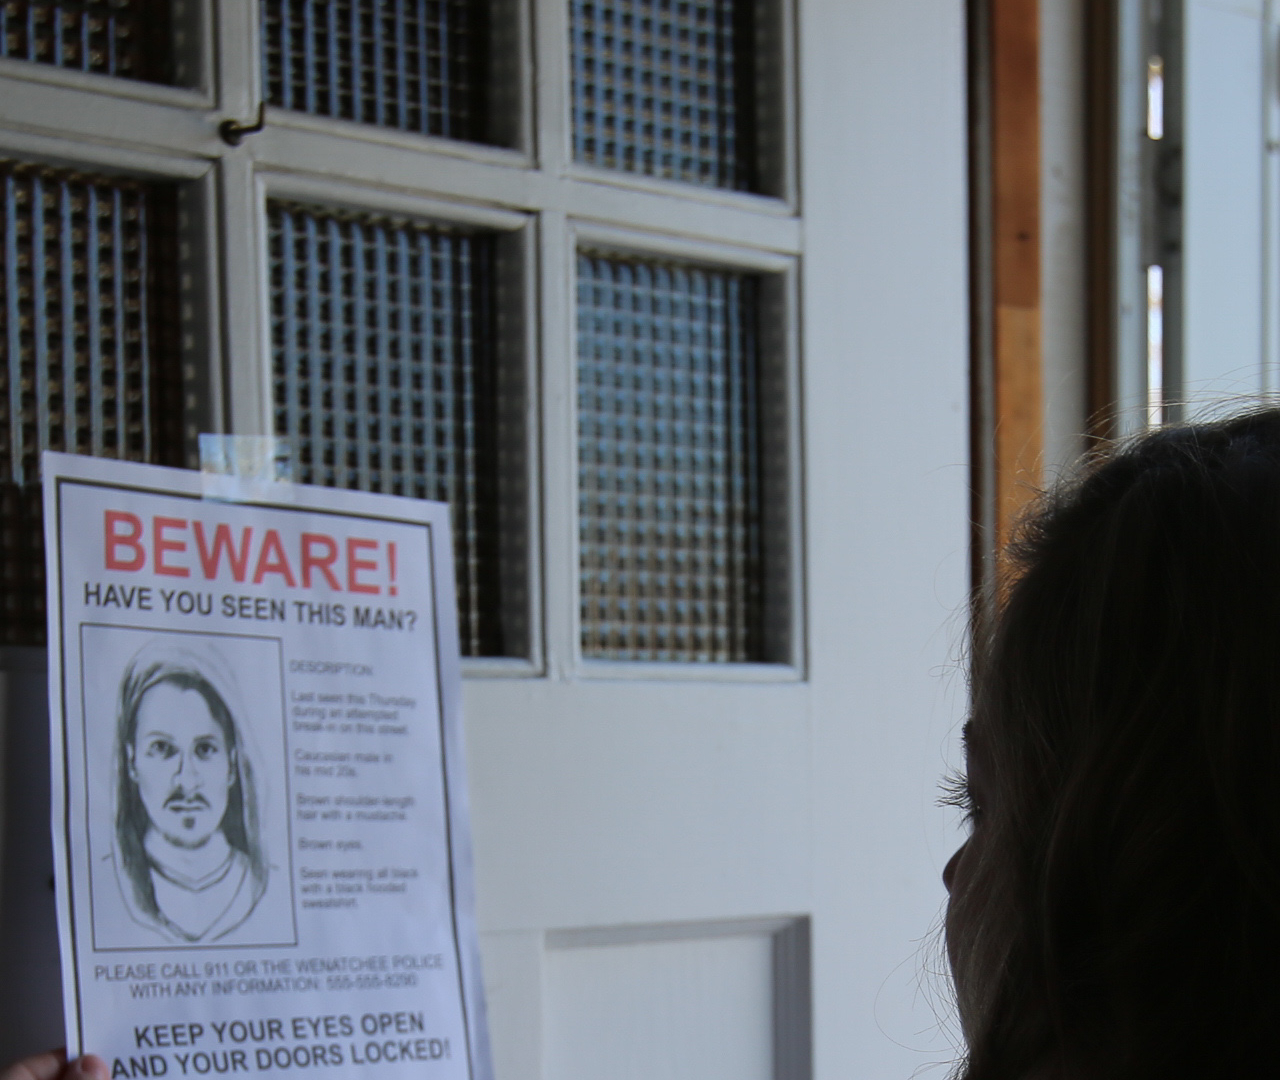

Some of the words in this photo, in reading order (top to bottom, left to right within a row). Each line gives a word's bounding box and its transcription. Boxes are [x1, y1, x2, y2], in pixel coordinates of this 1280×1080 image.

[104, 510, 398, 597] BEWARE!
[84, 582, 153, 611] HAVE
[160, 589, 213, 616] YOU
[222, 594, 286, 622] SEEN
[293, 601, 346, 627] THIS
[353, 606, 418, 633] MAN?
[291, 690, 315, 703] Last
[318, 693, 343, 703] seen
[369, 692, 417, 709] Thursday
[293, 705, 326, 720] during
[329, 709, 343, 718] an
[346, 708, 399, 722] attempted
[340, 723, 352, 733] on
[355, 722, 375, 734] this
[294, 748, 350, 762] Caucasian
[354, 752, 380, 763] male
[384, 753, 394, 763] in
[295, 765, 311, 776] his
[314, 766, 334, 776] mid
[296, 792, 330, 805] Brown
[297, 809, 317, 821] hair
[321, 809, 341, 821] with
[298, 837, 333, 850] Brown
[300, 867, 328, 879] Seen
[332, 869, 373, 881] wearing
[376, 868, 389, 879] all
[391, 868, 419, 880] black
[301, 883, 321, 894] with
[335, 883, 364, 894] black
[367, 882, 407, 894] hooded
[95, 963, 157, 981] PLEASE
[161, 962, 201, 979] CALL
[204, 961, 229, 977] 911
[233, 960, 257, 976] OR
[261, 959, 291, 974] THE
[295, 955, 388, 974] WENATCHEE
[392, 953, 443, 970] POLICE
[130, 981, 172, 999] WITH
[175, 981, 207, 996] ANY
[134, 1022, 204, 1049] KEEP
[211, 1018, 285, 1043] YOUR
[291, 1015, 354, 1040] EYES
[360, 1011, 425, 1036] OPEN
[111, 1054, 168, 1080] AND
[175, 1049, 249, 1075] YOUR
[255, 1043, 344, 1070] DOORS
[350, 1037, 451, 1065] LOCKED!
